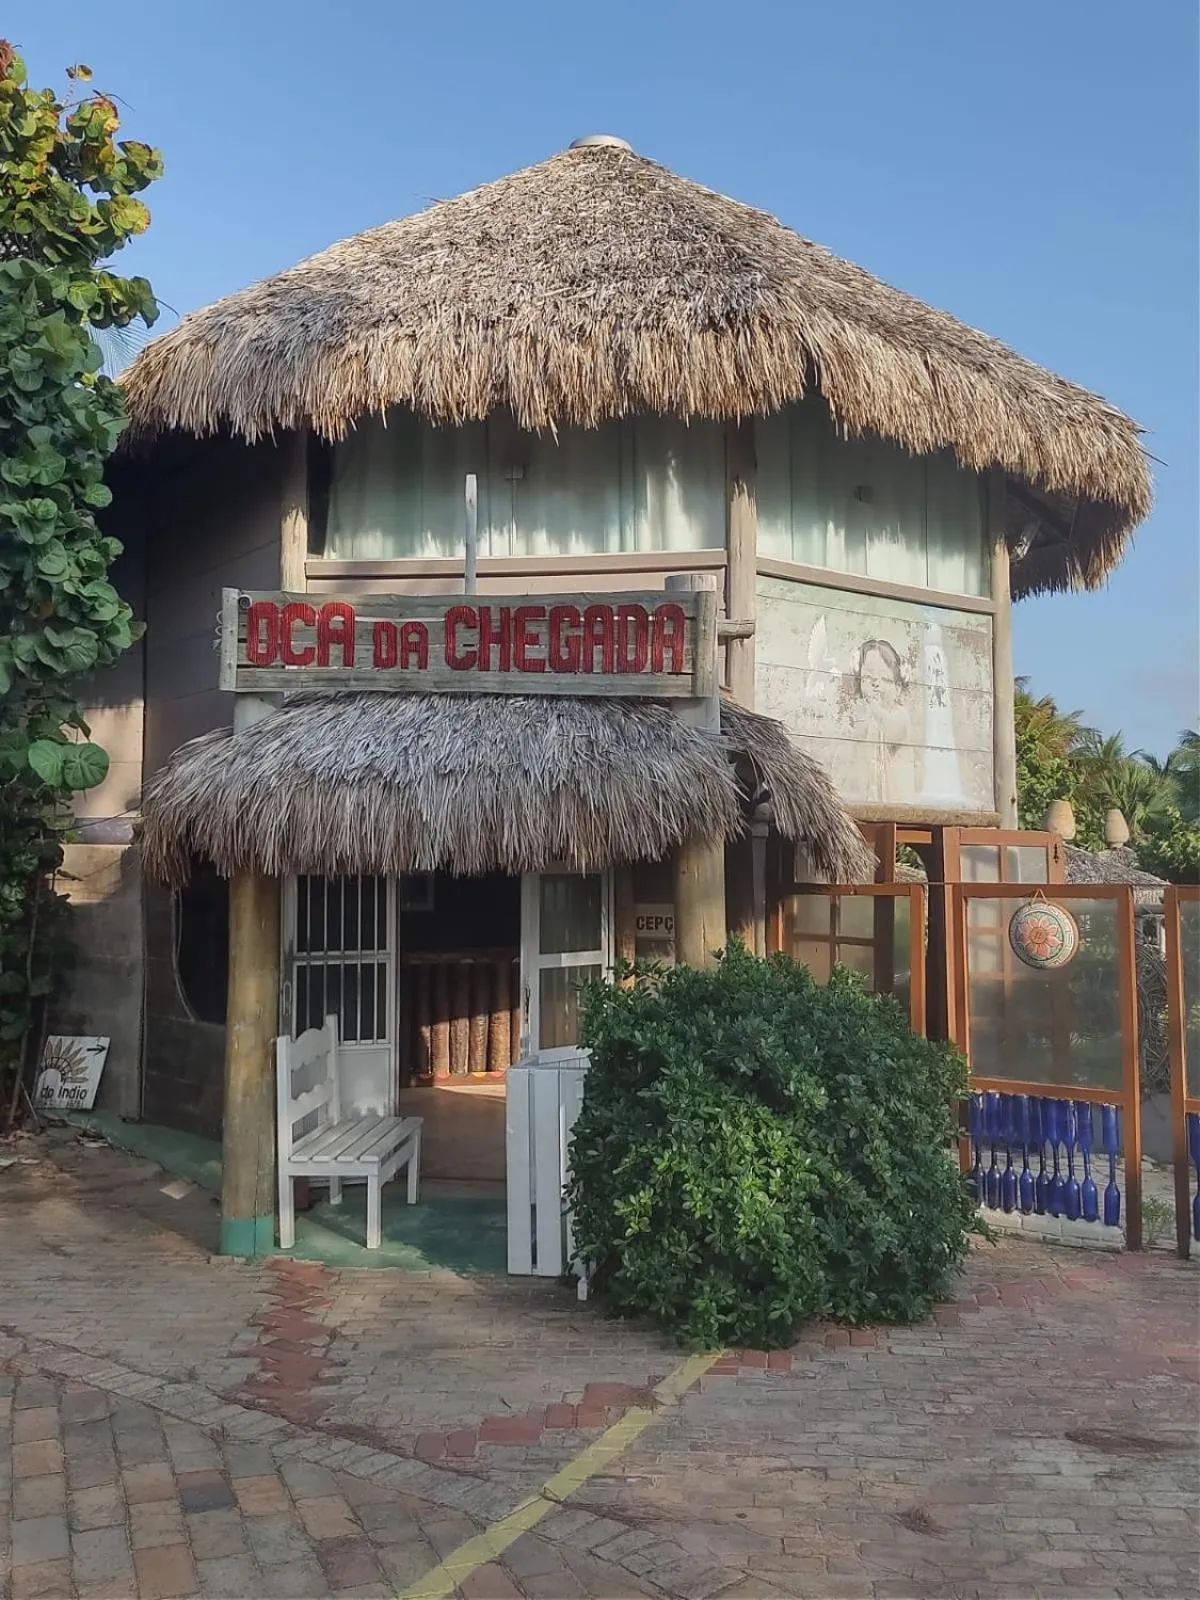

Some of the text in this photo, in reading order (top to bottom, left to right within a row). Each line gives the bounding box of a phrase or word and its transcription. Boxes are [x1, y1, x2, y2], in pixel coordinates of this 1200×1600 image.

[247, 602, 685, 674] OCA DA CHEGADA
[40, 1085, 54, 1099] do
